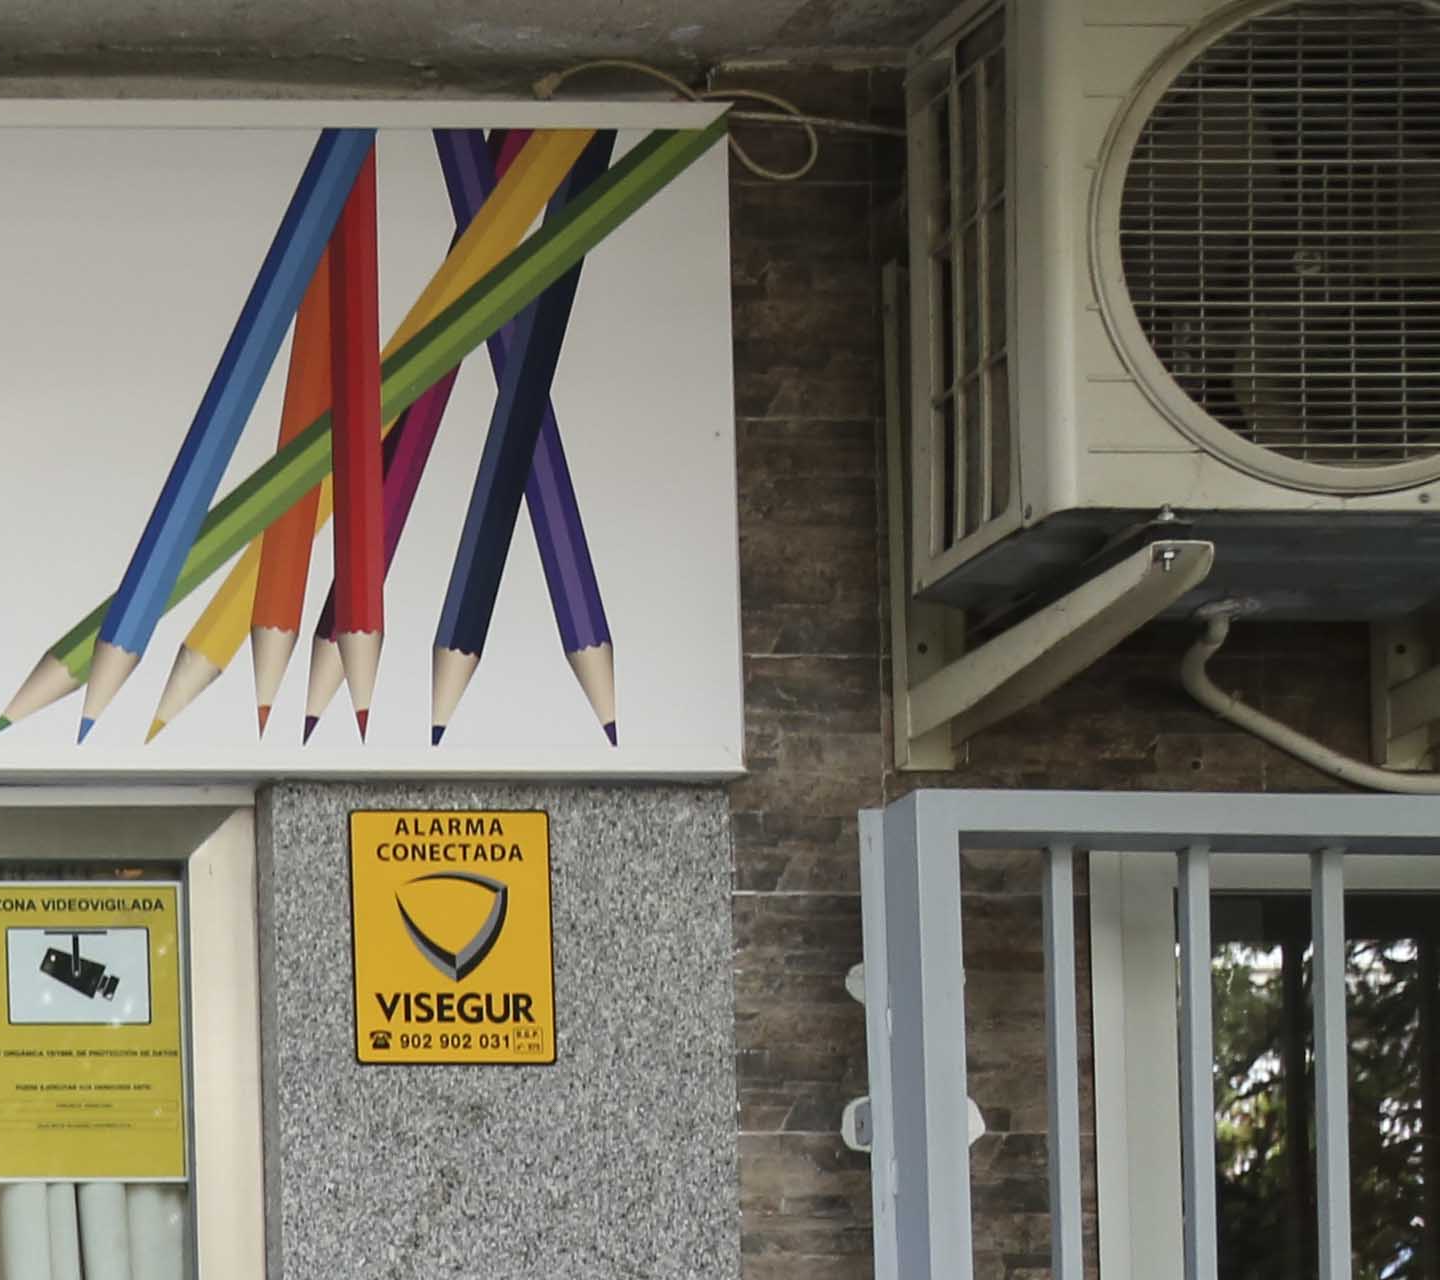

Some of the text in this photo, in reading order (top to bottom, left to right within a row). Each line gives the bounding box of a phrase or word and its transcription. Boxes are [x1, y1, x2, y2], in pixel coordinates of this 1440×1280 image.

[394, 818, 504, 837] ALARMA
[376, 843, 524, 863] CONECTADA
[41, 896, 165, 914] VIDEOVIGILADA
[374, 992, 535, 1024] VISEGUR
[400, 1033, 433, 1050] 902
[439, 1033, 473, 1050] 902
[479, 1033, 510, 1050] 031
